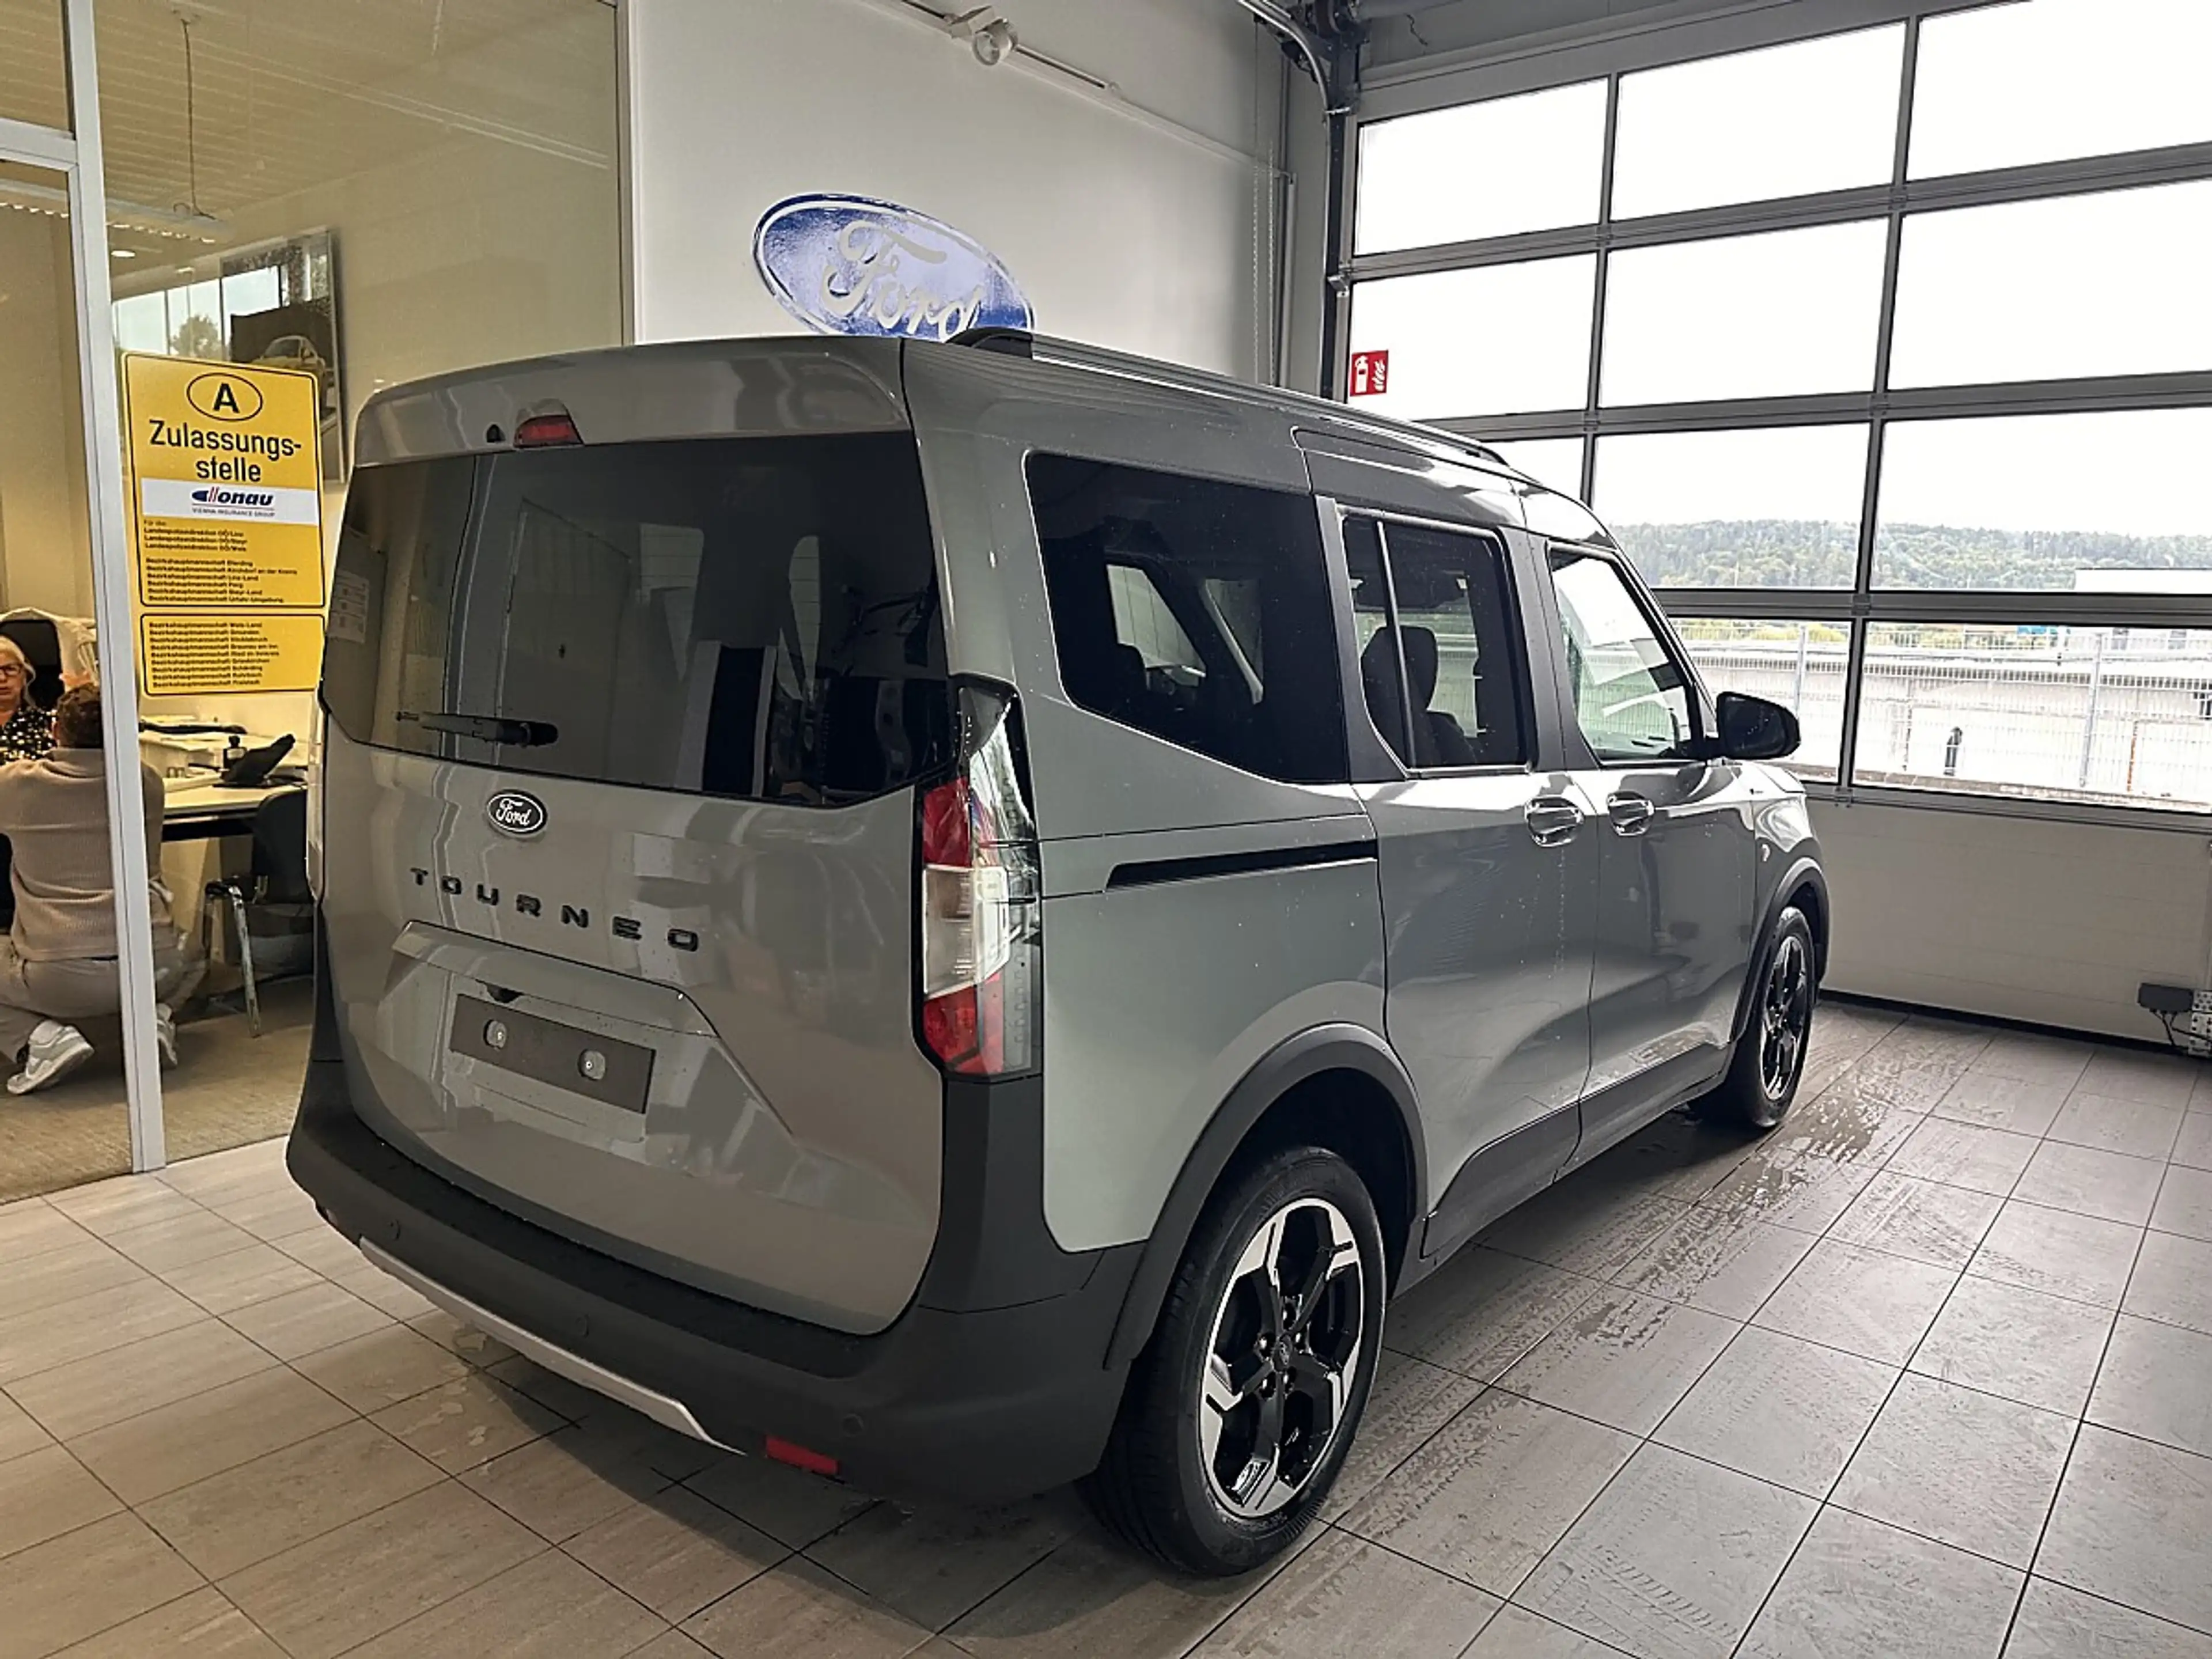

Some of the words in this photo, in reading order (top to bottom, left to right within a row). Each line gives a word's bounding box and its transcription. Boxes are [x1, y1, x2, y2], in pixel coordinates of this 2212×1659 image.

[820, 220, 983, 344] Ford
[213, 382, 240, 414] A
[149, 419, 301, 461] Zulassungs-
[196, 456, 261, 482] stelle
[495, 798, 532, 827] Ford
[410, 867, 699, 952] TOURNEO
